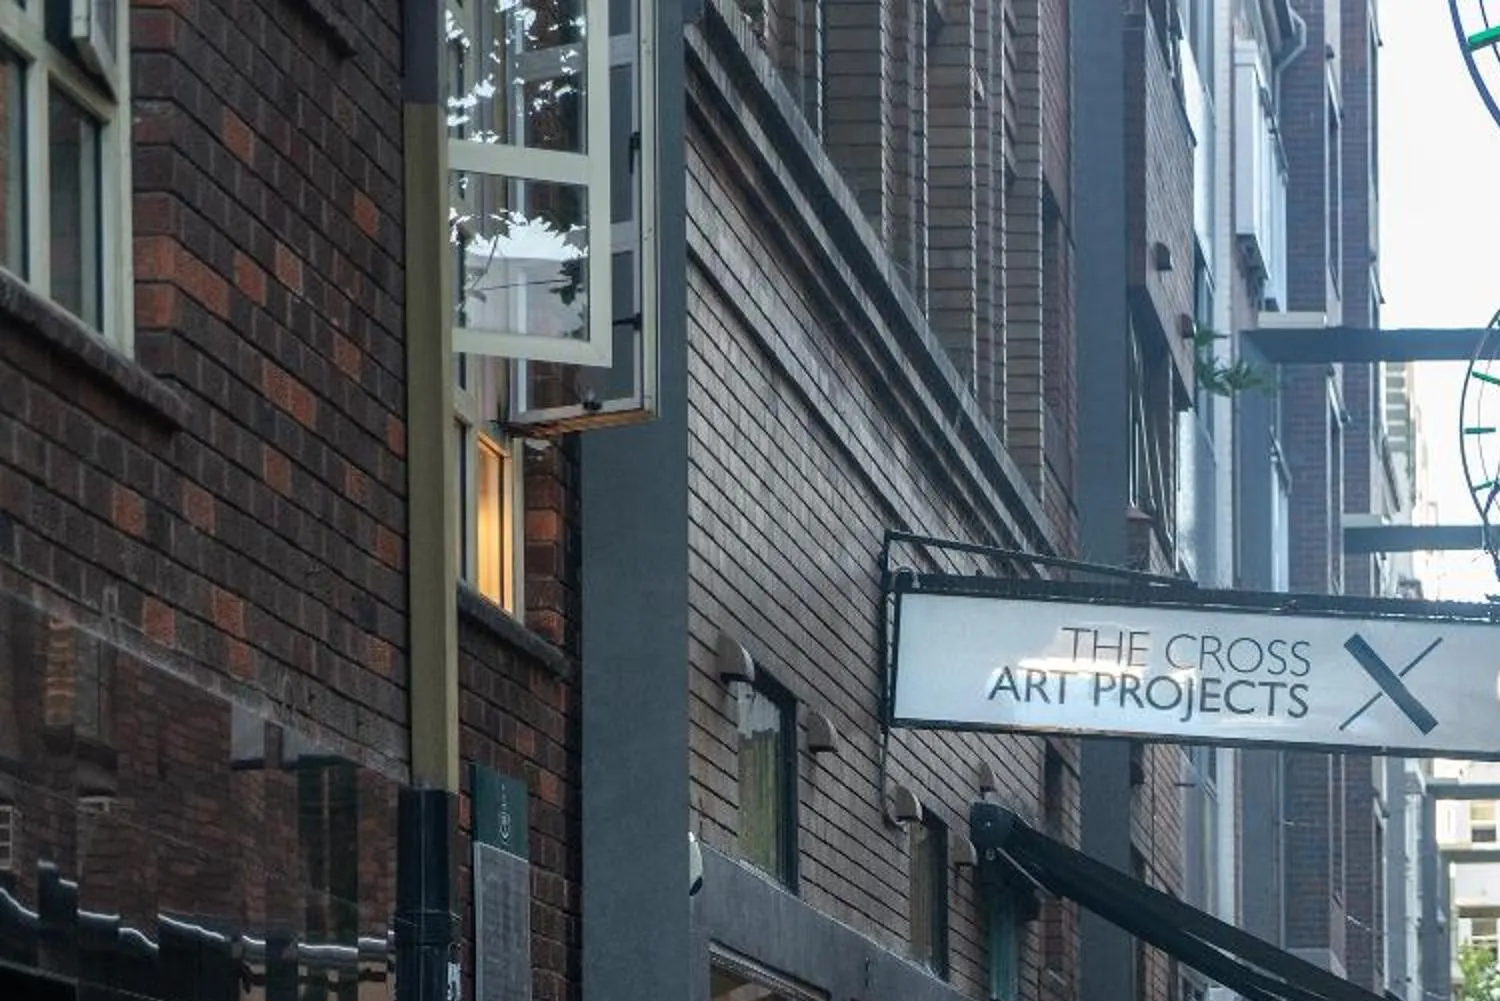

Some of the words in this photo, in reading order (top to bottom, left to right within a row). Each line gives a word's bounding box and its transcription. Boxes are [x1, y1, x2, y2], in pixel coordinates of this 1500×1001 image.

[1061, 626, 1150, 667] THE
[1165, 633, 1312, 677] CROSS
[987, 665, 1079, 705] ART
[1093, 671, 1310, 723] PROJECTS
